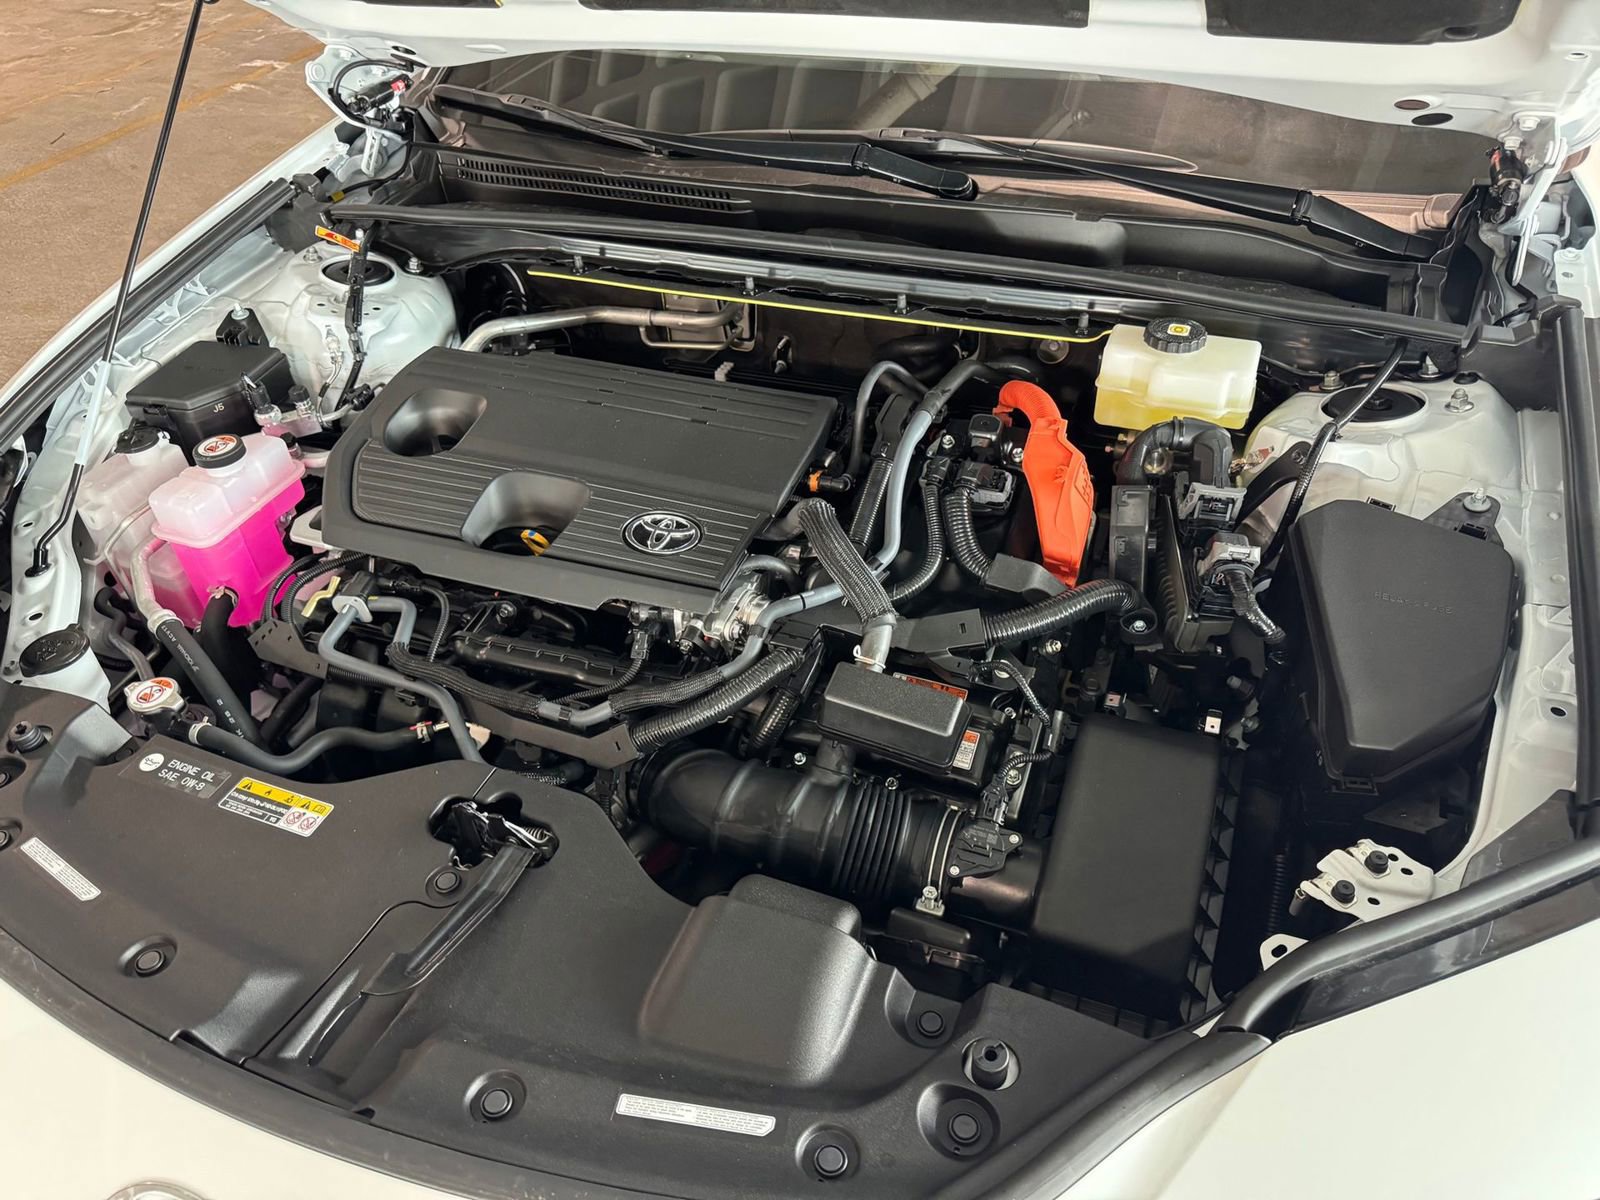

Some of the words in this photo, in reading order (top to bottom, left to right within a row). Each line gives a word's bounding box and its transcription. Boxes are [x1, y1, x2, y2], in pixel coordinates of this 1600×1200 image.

[213, 402, 225, 413] J5
[158, 769, 180, 782] SAE
[181, 777, 205, 791] 0W-8
[167, 759, 201, 776] ENGINE
[201, 771, 215, 782] OIL
